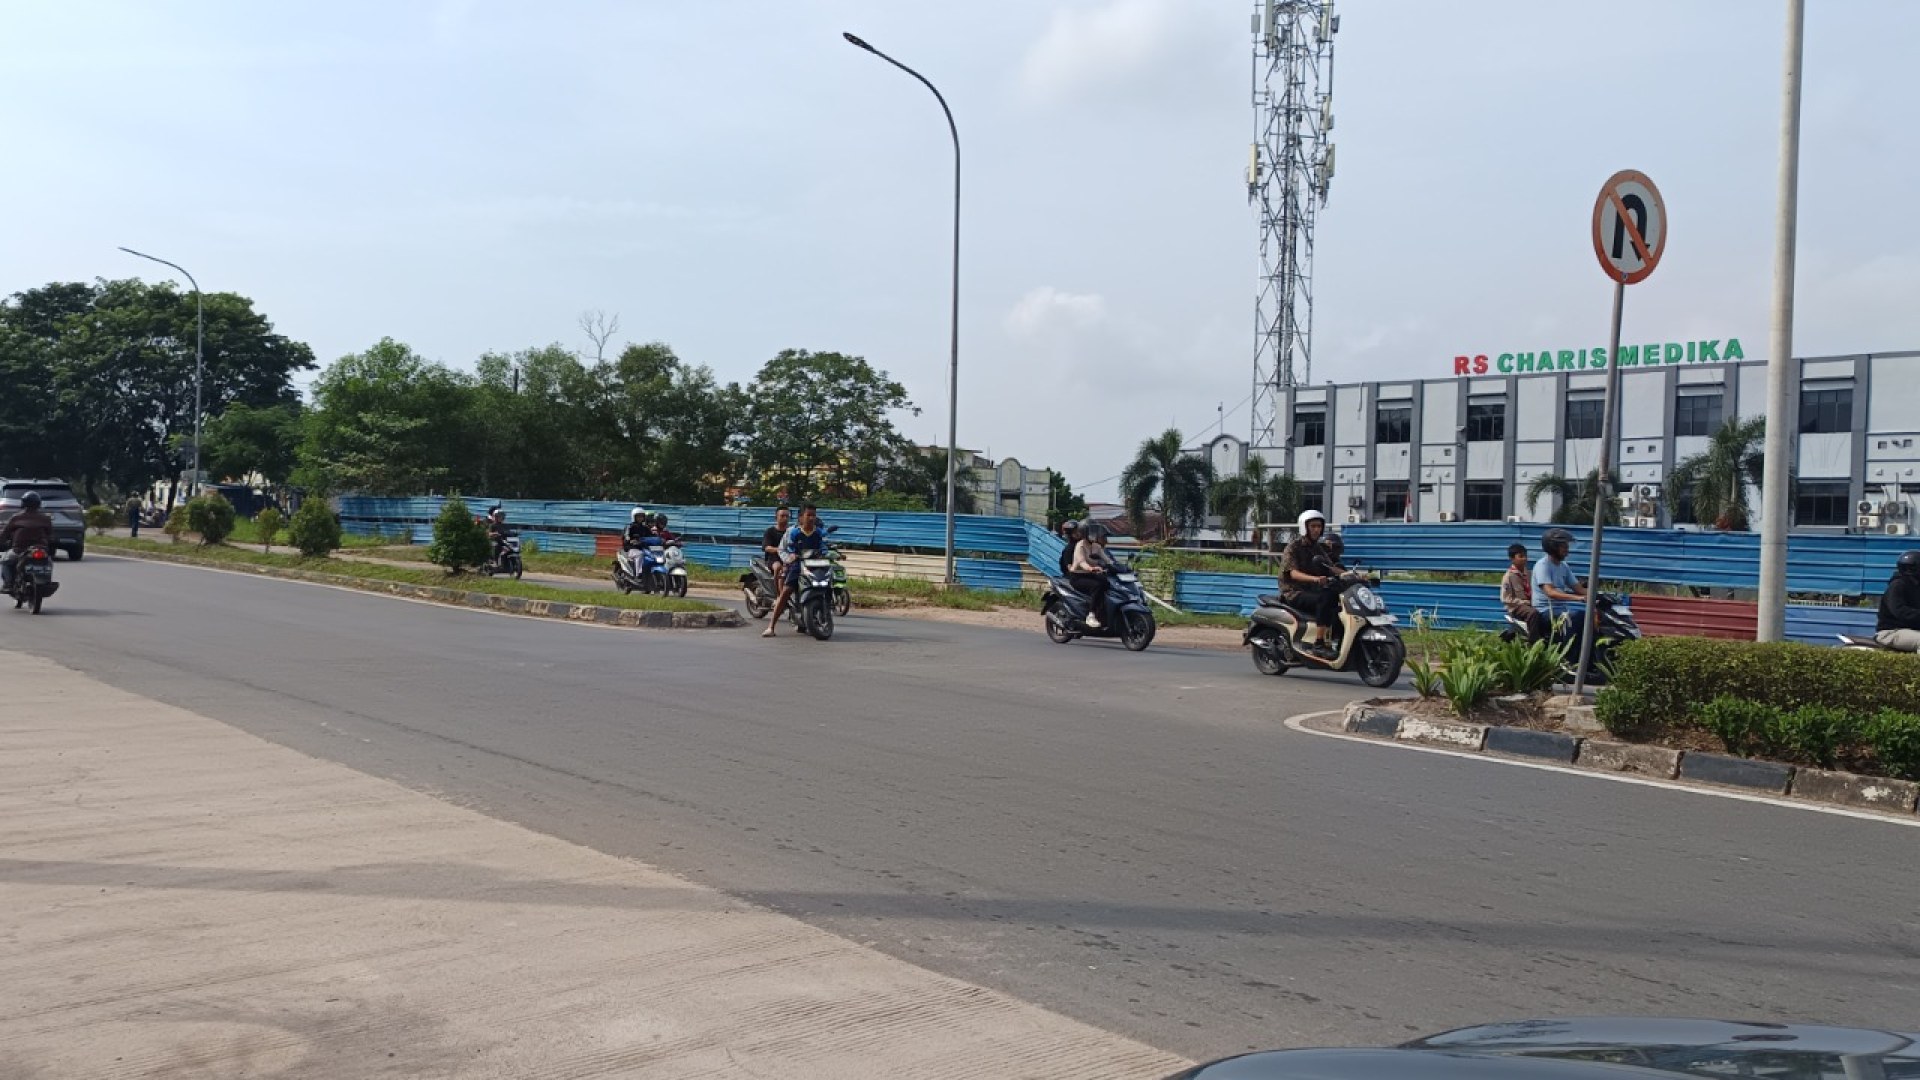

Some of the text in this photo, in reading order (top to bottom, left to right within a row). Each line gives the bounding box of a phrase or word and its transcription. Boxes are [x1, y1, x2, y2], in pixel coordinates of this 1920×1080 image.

[1454, 338, 1744, 375] RS CHARIS MEDIKA
